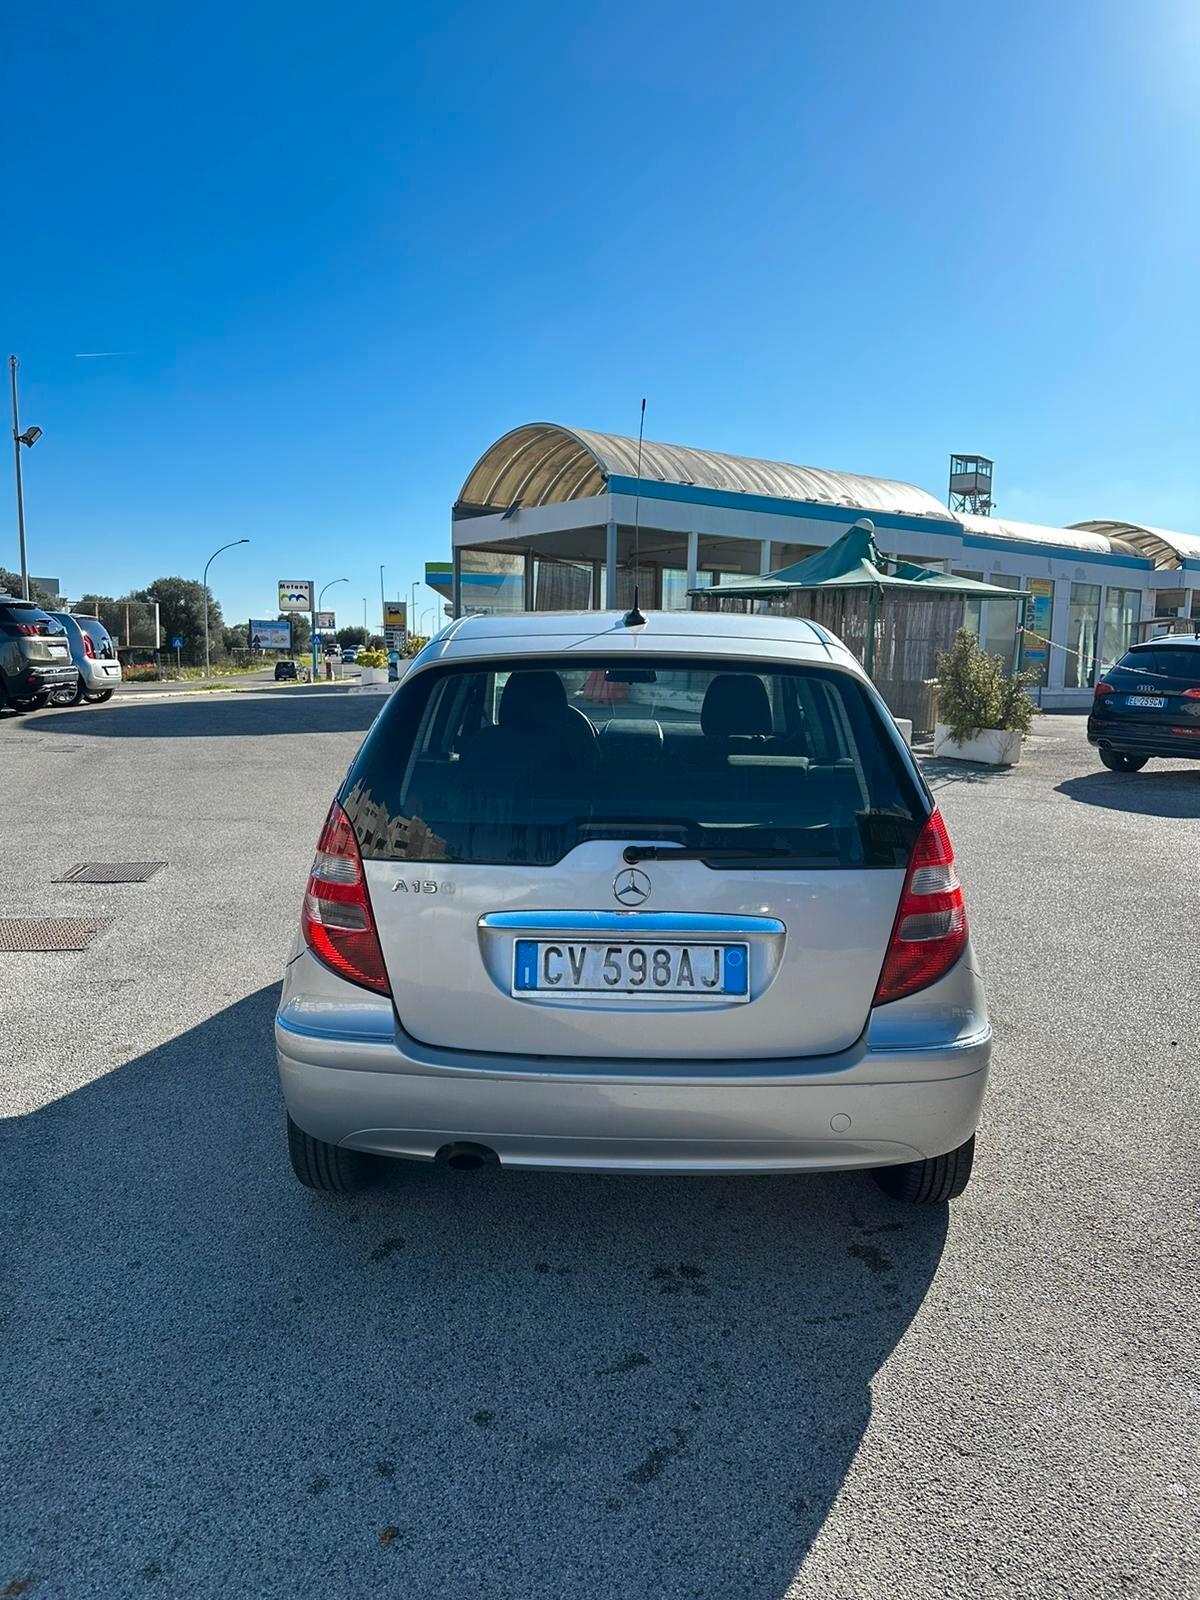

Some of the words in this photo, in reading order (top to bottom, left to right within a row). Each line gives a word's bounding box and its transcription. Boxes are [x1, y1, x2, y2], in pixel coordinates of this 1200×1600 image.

[391, 879, 457, 895] A150
[543, 946, 587, 985] CV
[603, 947, 720, 988] 598AJ
